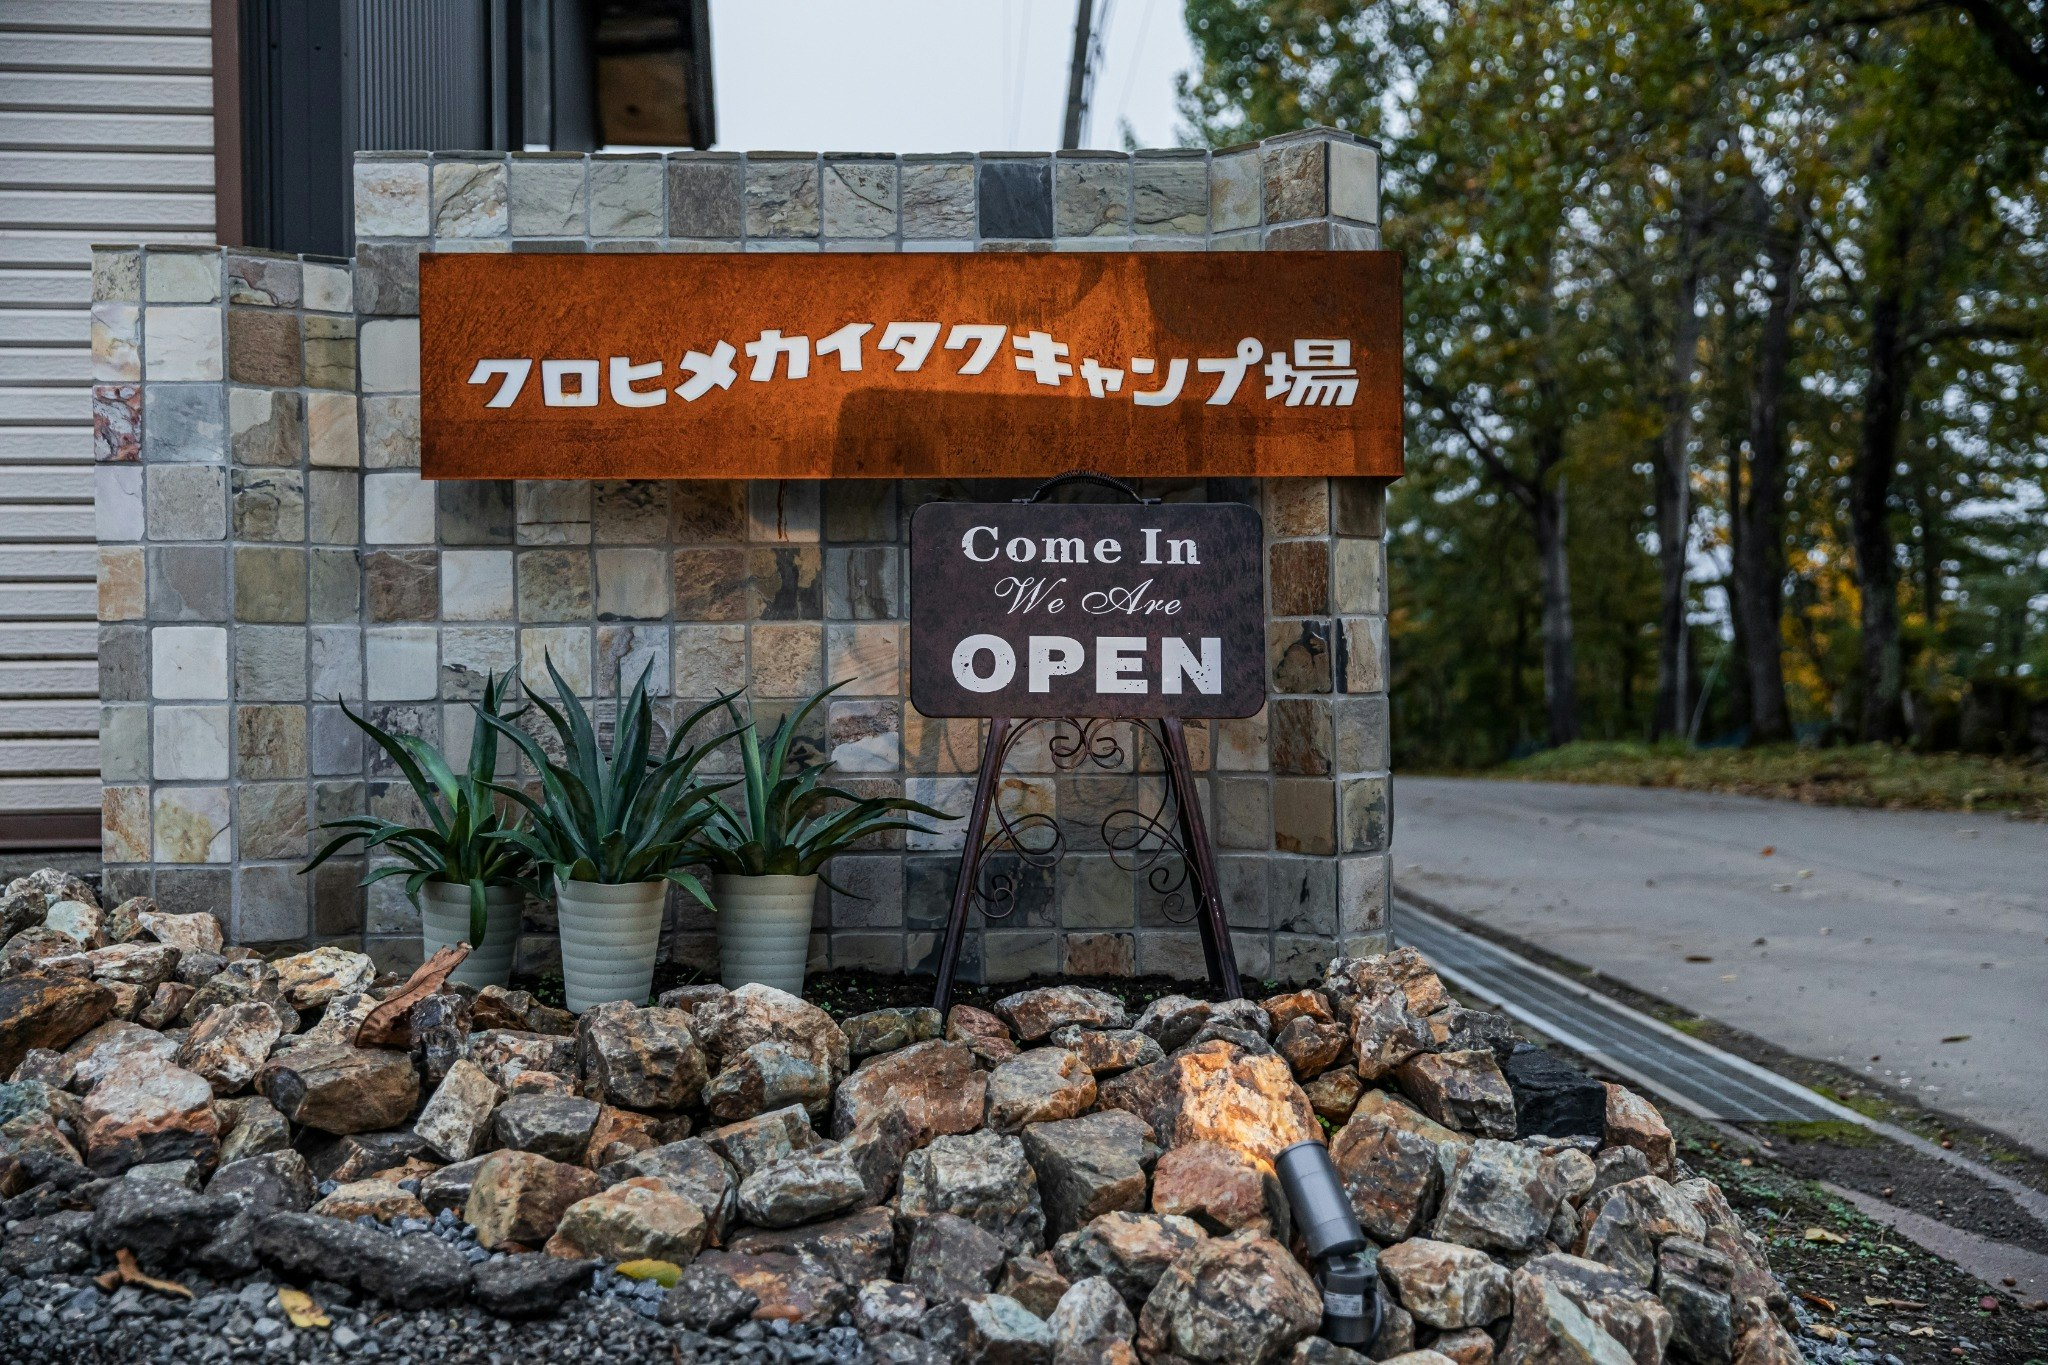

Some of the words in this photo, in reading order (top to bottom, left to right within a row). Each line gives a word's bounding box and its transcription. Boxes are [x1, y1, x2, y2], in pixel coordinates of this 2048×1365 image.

[466, 320, 1360, 409] クロヒメカイタクキャンプ場
[961, 525, 1122, 563] Come
[1140, 528, 1201, 565] In
[994, 576, 1067, 615] We
[1081, 578, 1182, 616] Are
[951, 633, 1222, 695] OPEN
